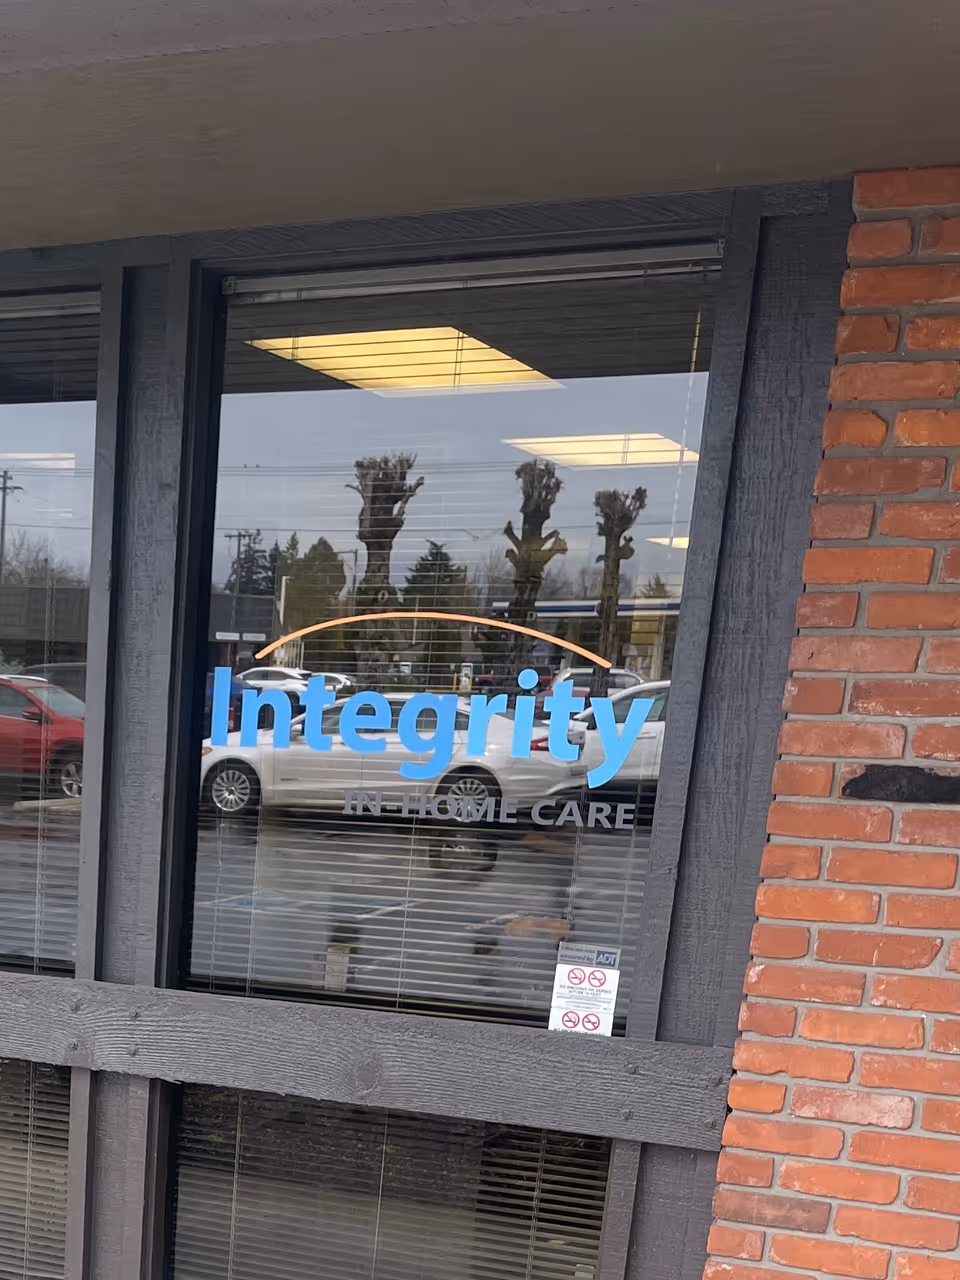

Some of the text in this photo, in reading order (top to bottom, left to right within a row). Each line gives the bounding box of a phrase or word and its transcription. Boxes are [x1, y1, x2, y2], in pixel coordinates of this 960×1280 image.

[210, 666, 655, 788] Integrity
[342, 790, 637, 829] IN-HOME CARE
[596, 953, 617, 965] ADT
